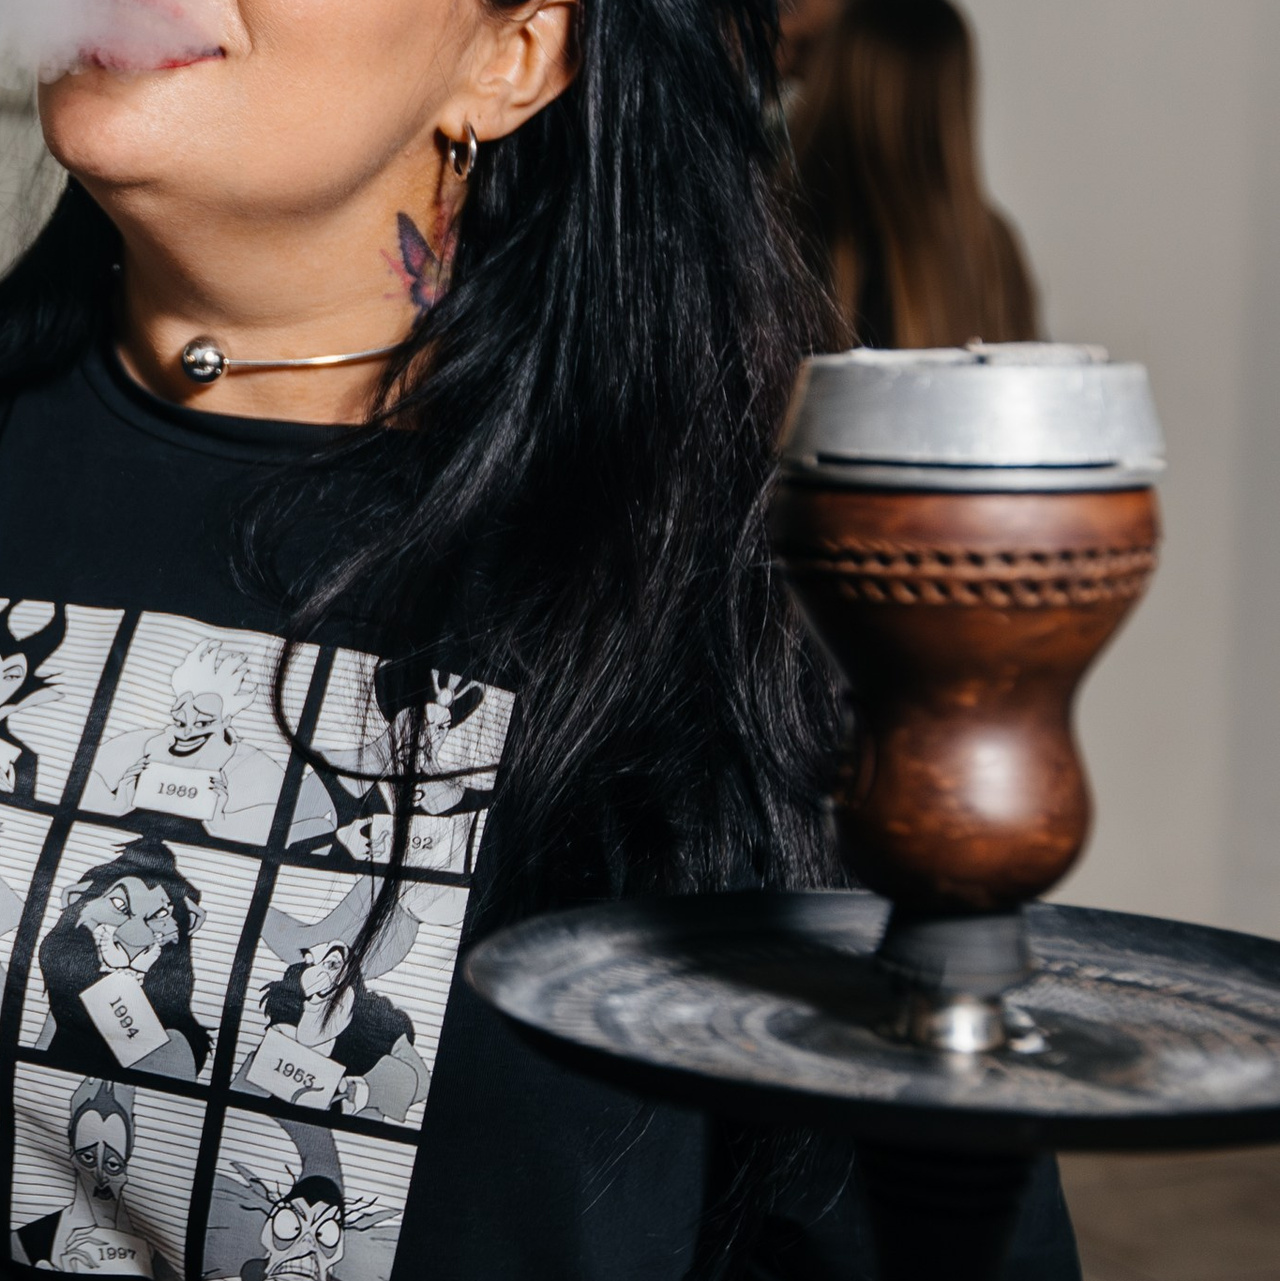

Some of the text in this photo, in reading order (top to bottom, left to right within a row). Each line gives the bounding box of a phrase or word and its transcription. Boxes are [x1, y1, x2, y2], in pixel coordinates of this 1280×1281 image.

[156, 782, 199, 799] 1989
[411, 835, 434, 850] 92
[109, 997, 139, 1040] 1994
[274, 1058, 316, 1088] 1953
[97, 1246, 137, 1261] 1997
